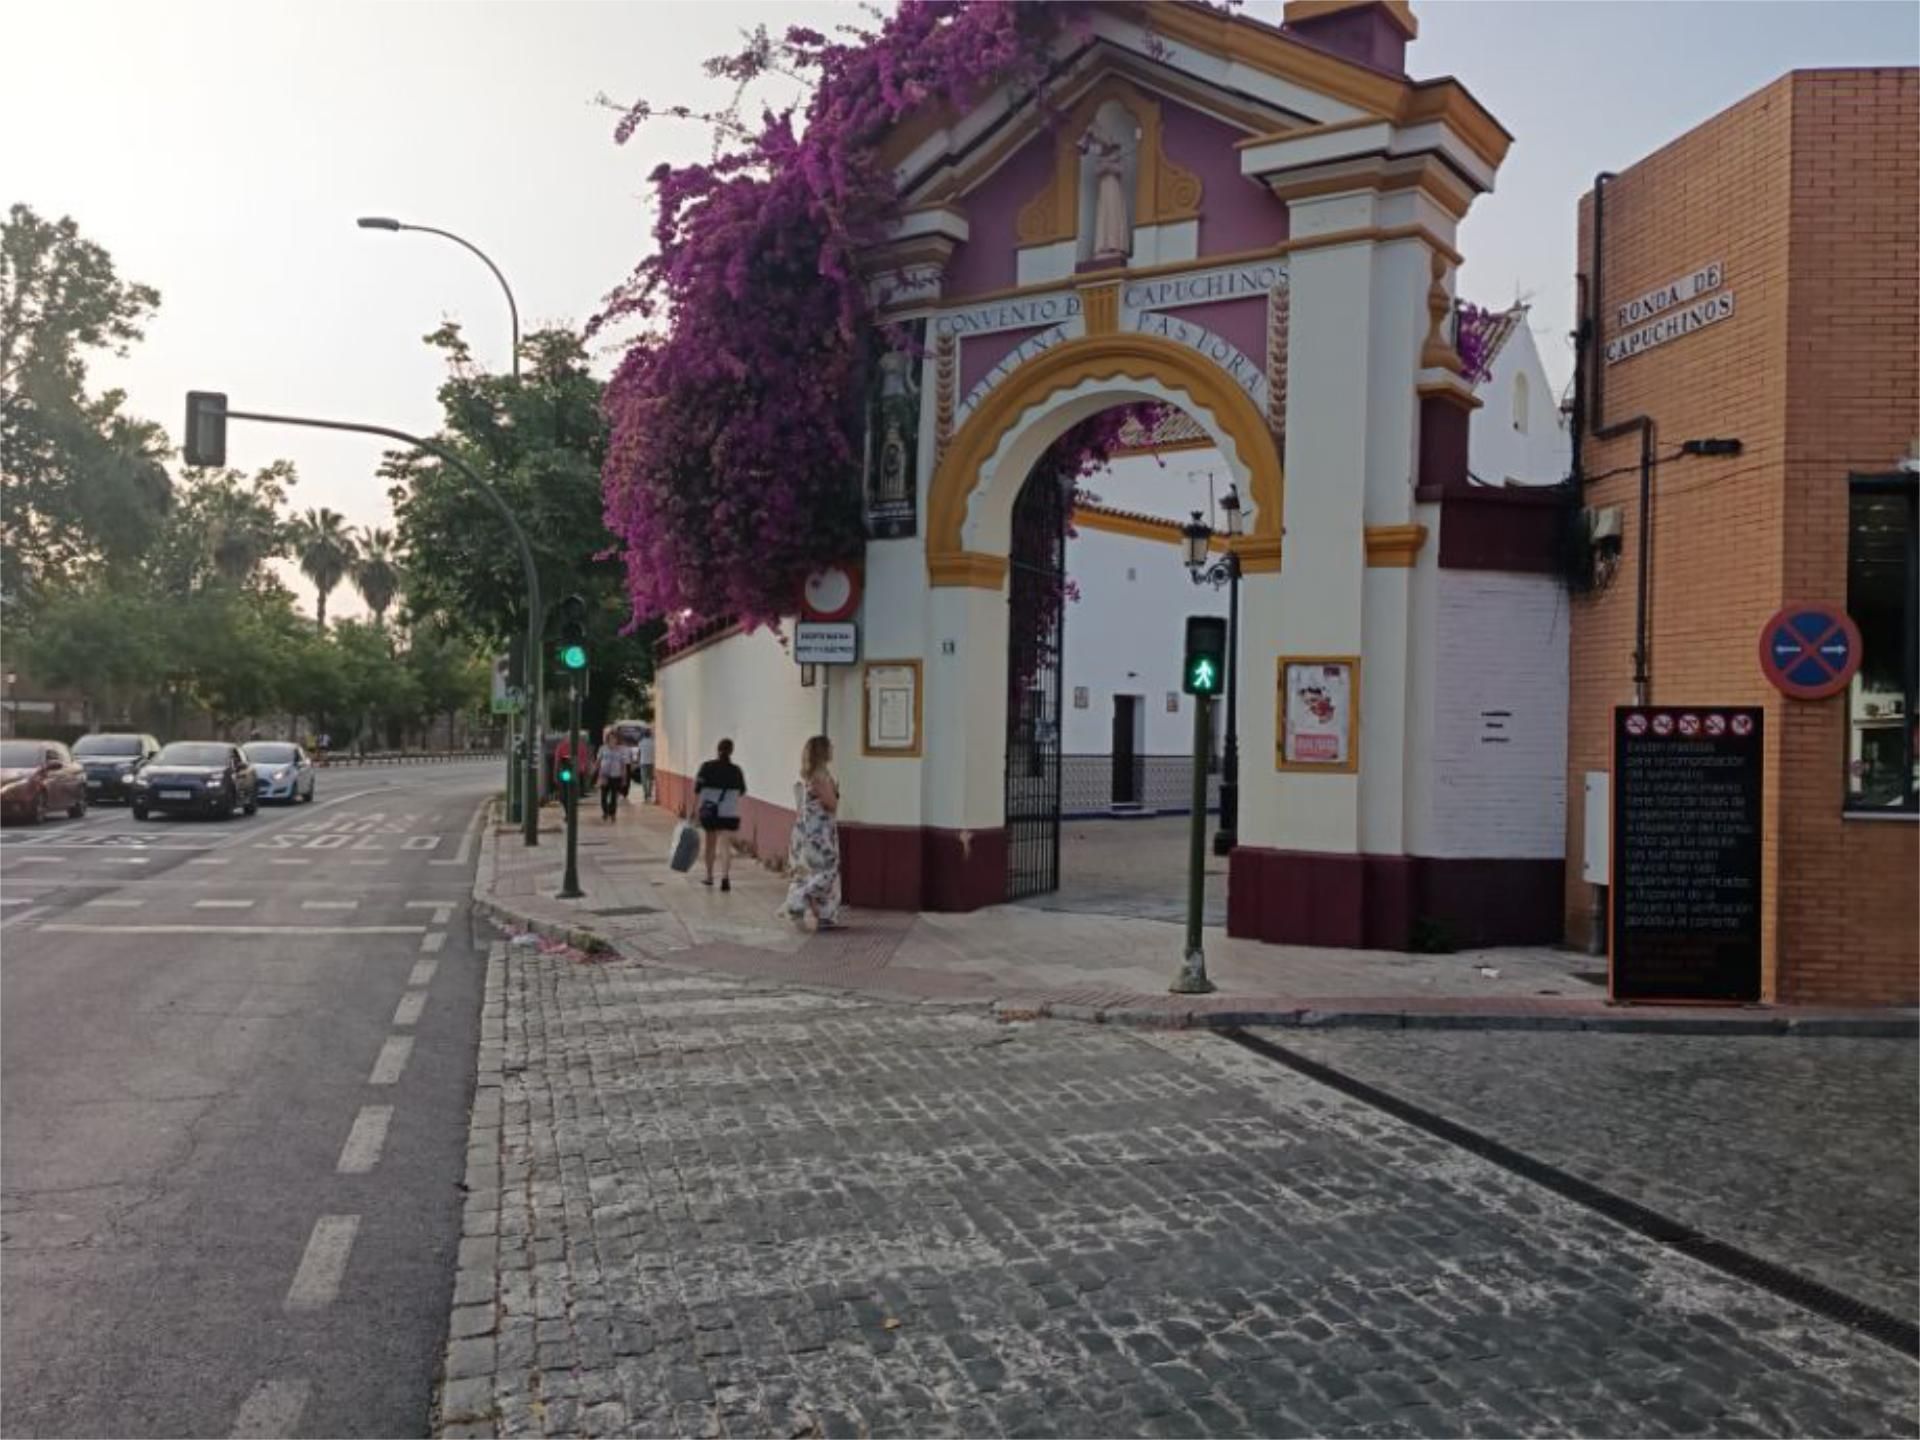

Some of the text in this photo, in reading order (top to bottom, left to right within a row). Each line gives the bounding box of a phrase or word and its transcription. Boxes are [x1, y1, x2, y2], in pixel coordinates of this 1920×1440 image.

[1124, 265, 1289, 308] CAPUCHINOS
[1618, 264, 1719, 327] RONDA DE
[1137, 312, 1262, 393] PASTORA
[1605, 294, 1730, 361] CAPUCHINOS
[251, 834, 440, 851] SOLO
